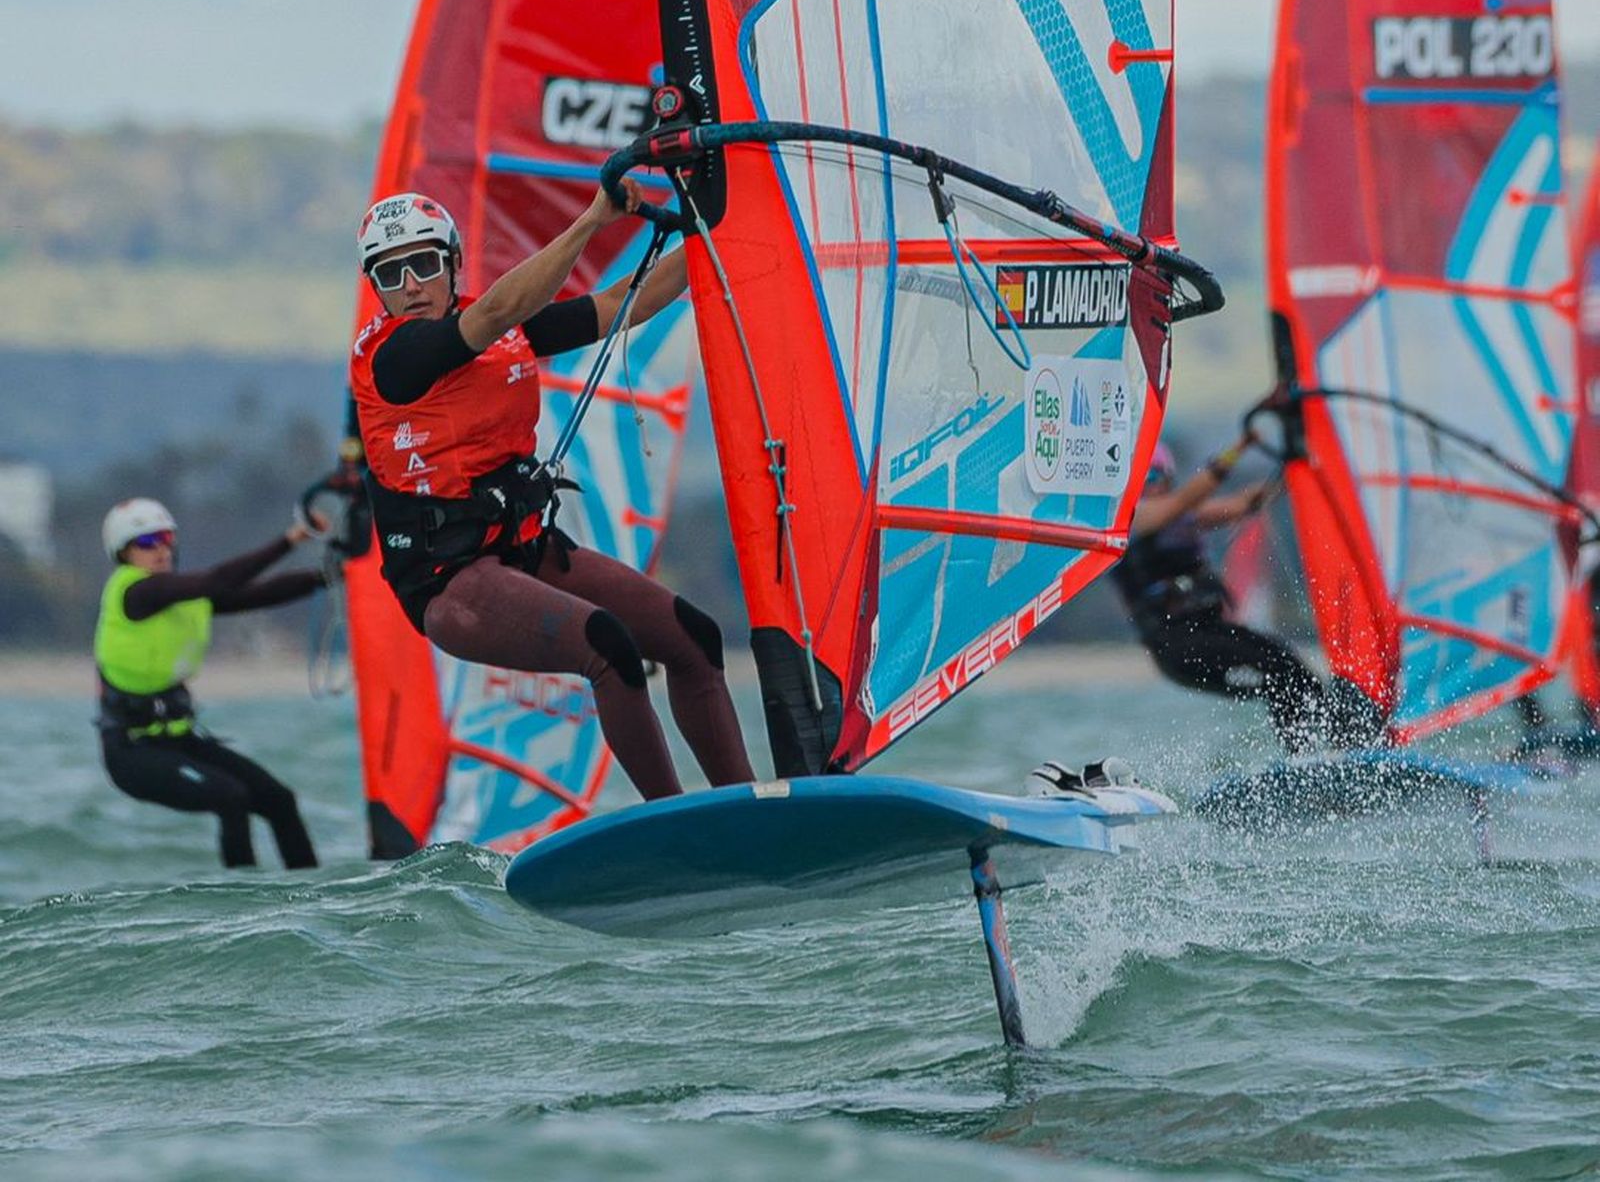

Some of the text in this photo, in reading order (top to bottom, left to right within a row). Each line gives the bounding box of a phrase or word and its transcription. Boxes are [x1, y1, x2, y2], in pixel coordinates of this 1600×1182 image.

[1373, 15, 1553, 79] POL 230
[542, 77, 650, 148] CZE
[1025, 270, 1039, 324] P.
[1043, 269, 1127, 324] LAMADRID
[1034, 390, 1060, 419] Ellas
[1064, 438, 1096, 457] PUERTO
[1064, 462, 1095, 480] SHERRY
[889, 576, 1064, 741] SEVERNE
